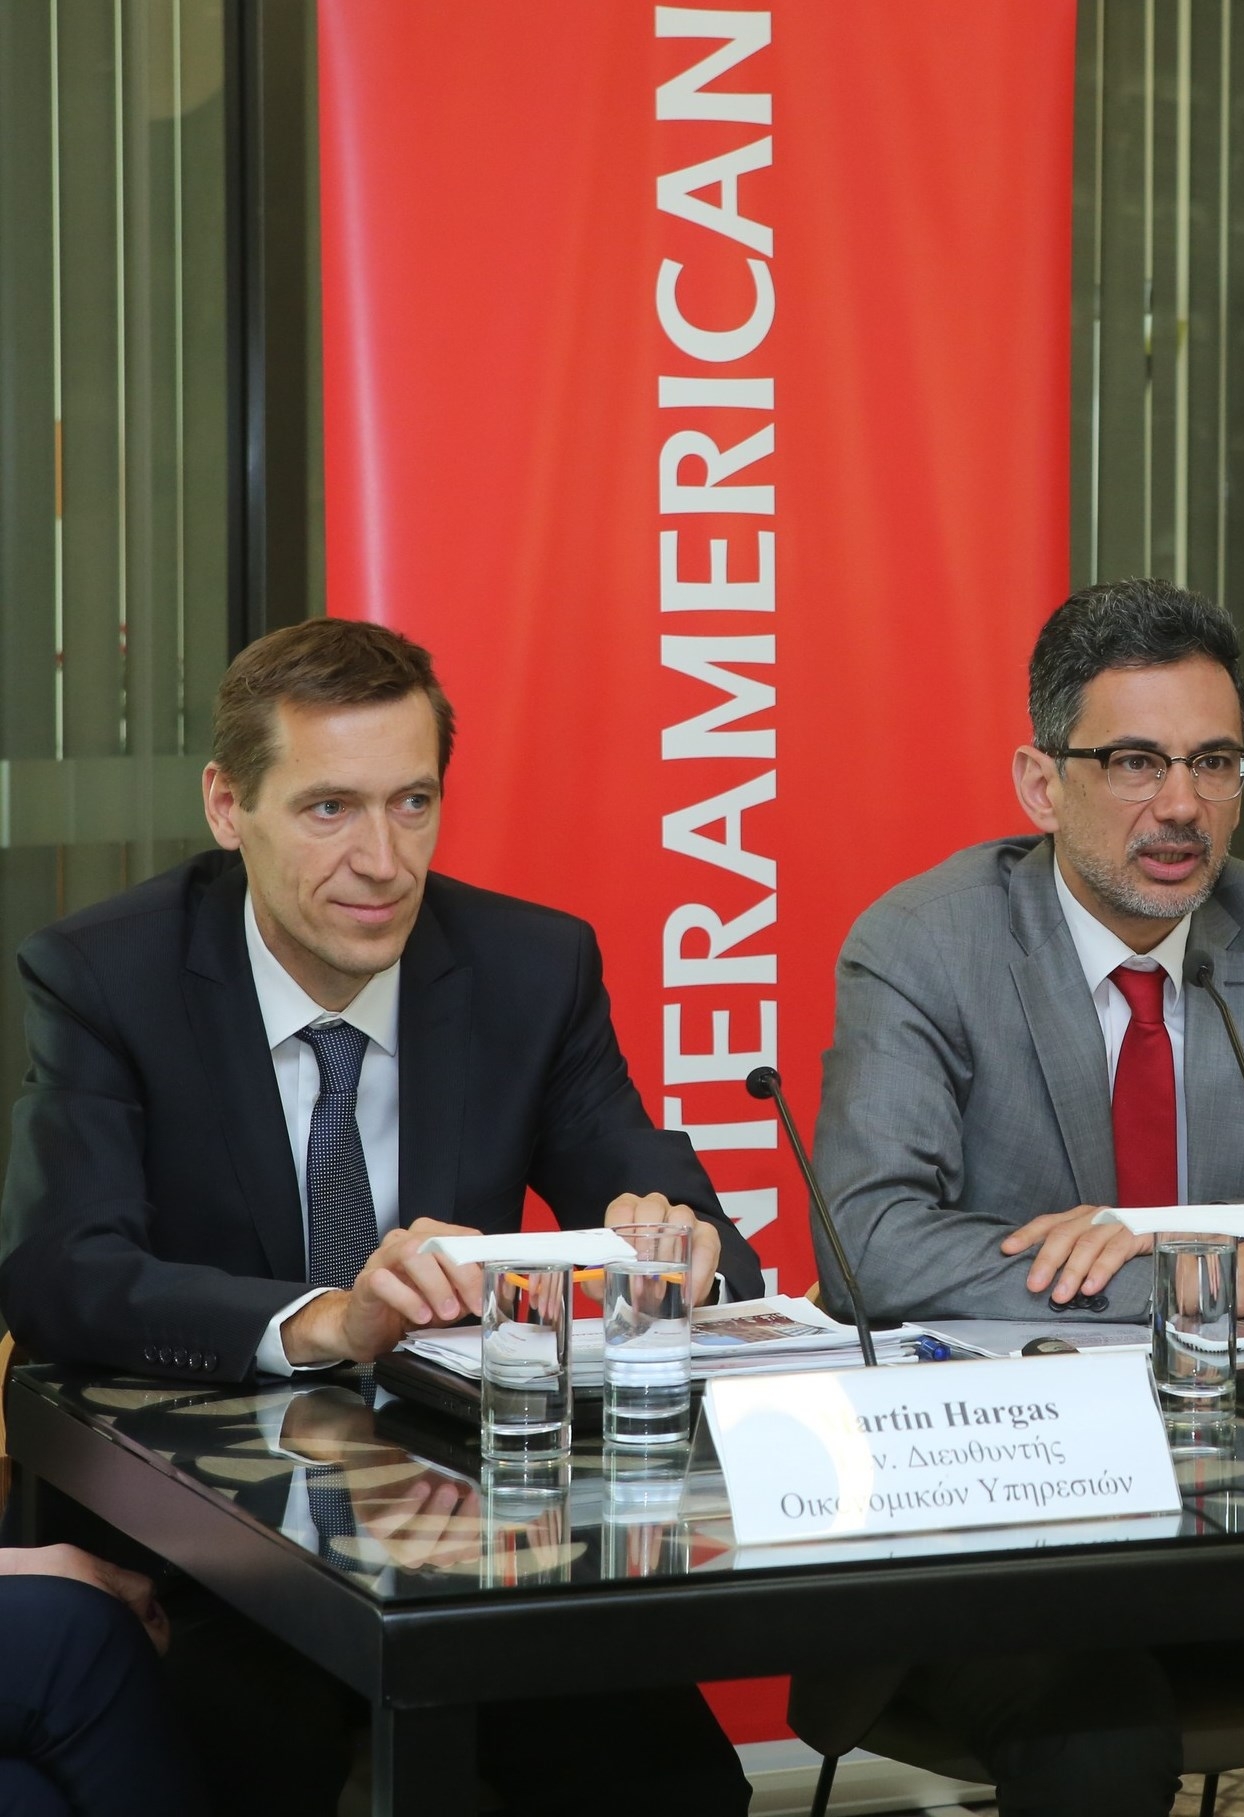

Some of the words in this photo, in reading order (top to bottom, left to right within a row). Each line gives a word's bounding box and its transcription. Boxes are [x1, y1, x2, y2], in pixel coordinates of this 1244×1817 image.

[847, 1405, 933, 1433] artin
[943, 1401, 1059, 1429] Hargas
[909, 1436, 1065, 1468] Διευθυντής
[977, 1470, 1132, 1507] Υπηρεσιών
